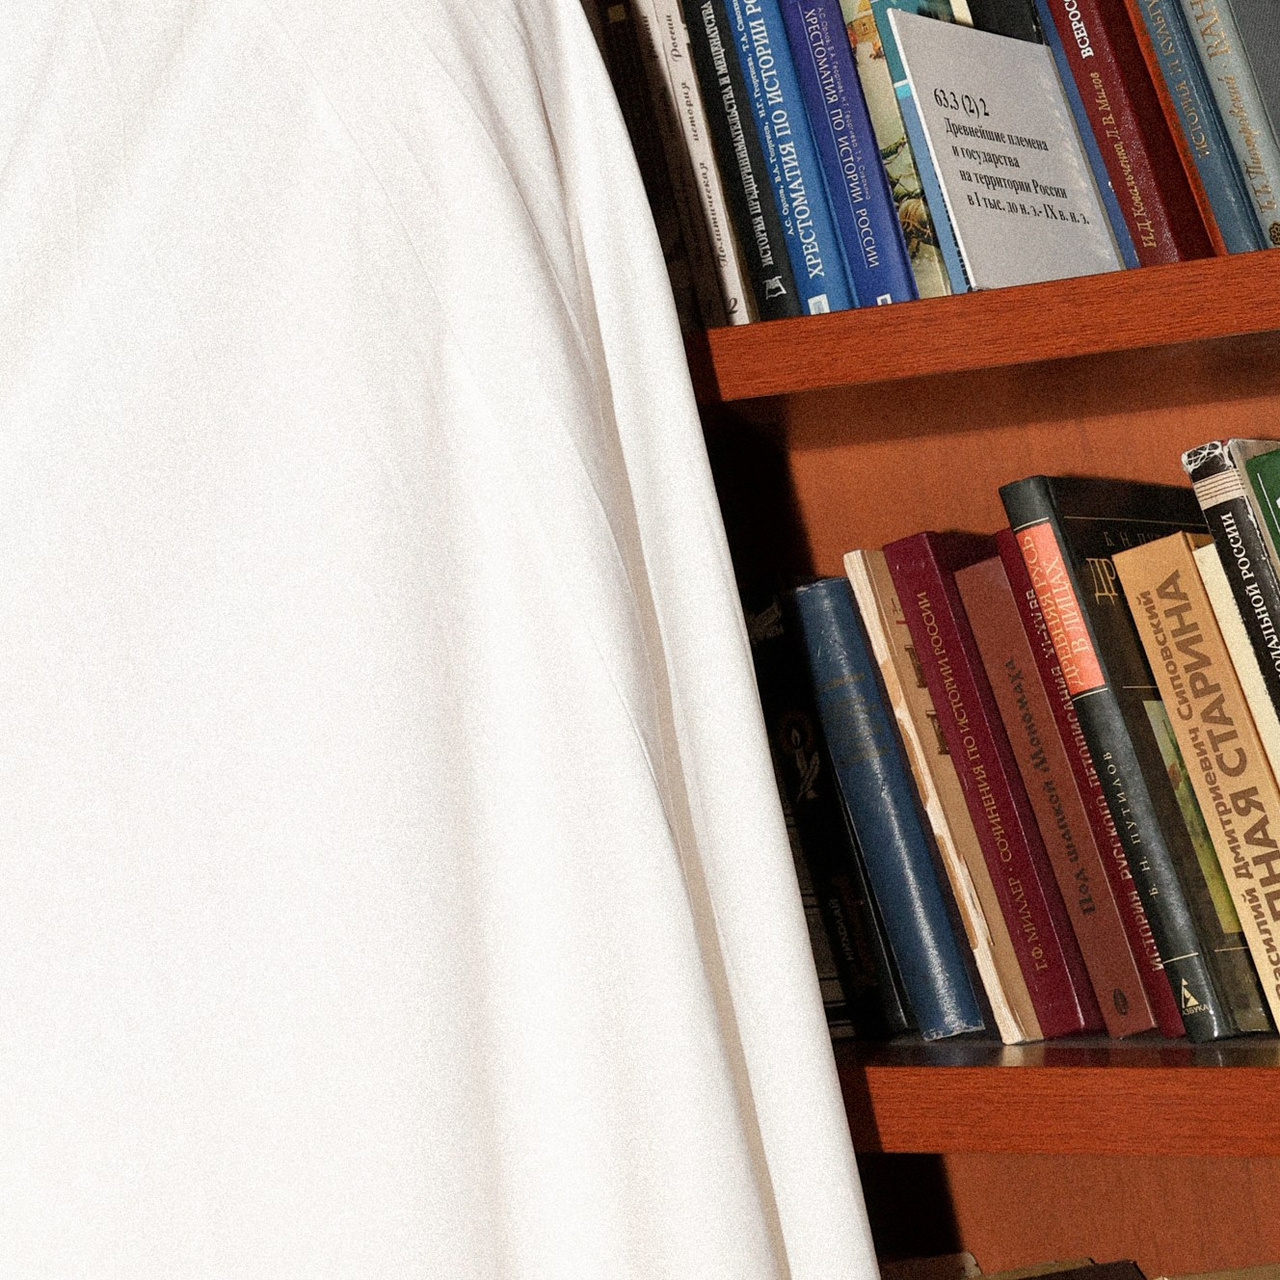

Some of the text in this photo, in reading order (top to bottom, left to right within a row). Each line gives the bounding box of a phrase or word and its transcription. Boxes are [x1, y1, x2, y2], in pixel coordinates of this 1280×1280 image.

[701, 1, 728, 75] МЕЦЕНАТСТВА
[749, 18, 783, 105] ИСТОРИИ
[1167, 59, 1182, 75] И
[772, 109, 791, 137] ПО
[934, 88, 959, 110] 63.3
[1089, 72, 1111, 111] Милов
[1175, 80, 1210, 158] ИСТОРИЯ
[1218, 69, 1275, 180] Пиотровский
[666, 14, 730, 269] Политическая история России
[722, 85, 761, 214] ПРЕДПРИНИМАТЕЛЬСТВА
[805, 9, 879, 267] ХРЕСТОМАТИЯ ПО ИСТОРИИ РОССИИ
[944, 117, 1048, 151] Древнейшие племена
[952, 145, 1020, 168] и государства
[779, 141, 825, 278] ХРЕСТОМАТИЯ
[959, 170, 1068, 199] на территории России
[967, 192, 1090, 224] в I тыс. до н. IX в. н. э.
[753, 215, 774, 266] ИСТОРИЯ
[1221, 512, 1254, 580] РОССИИ
[1023, 532, 1087, 688] ДРЕВНЯЯ РУСЬ
[1042, 554, 1091, 652] В ЛИЦАХ
[1156, 569, 1247, 777] СТАРИНА
[916, 591, 1038, 943] МИЛЛЕР СОЧИНЕНИЯ ПО ИСТОРИИ РОССИИ
[1136, 590, 1253, 879] Дмитриевич Сиповский
[1005, 658, 1096, 915] Под шапкой Мономаха
[1103, 749, 1146, 844] ПУТИЛОВ
[1140, 856, 1151, 871] Н.
[1130, 890, 1164, 970] ИСТОРИЯ
